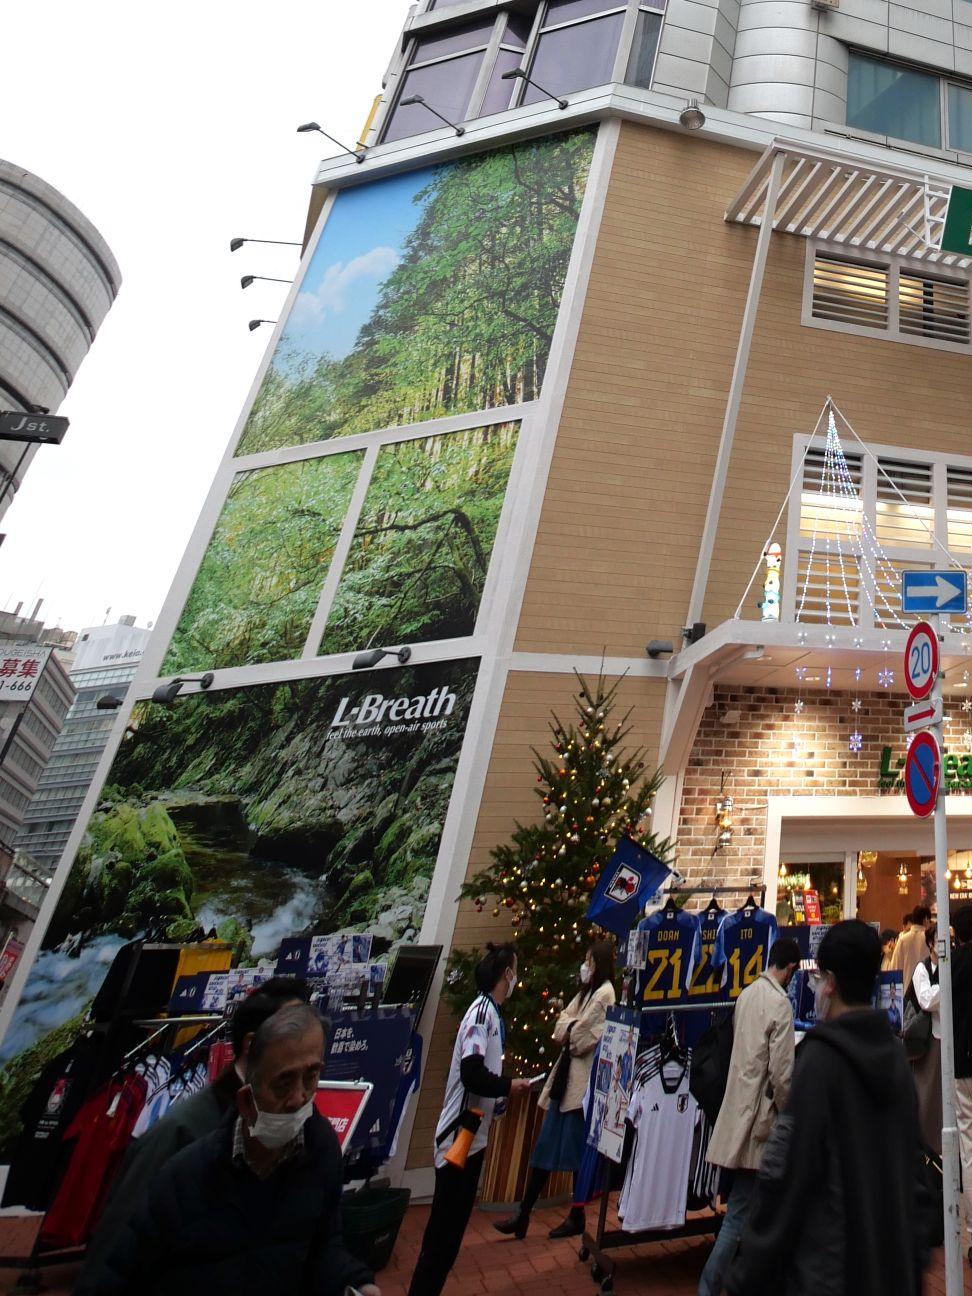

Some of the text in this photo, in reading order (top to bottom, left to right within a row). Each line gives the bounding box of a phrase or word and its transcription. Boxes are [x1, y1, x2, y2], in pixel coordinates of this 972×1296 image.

[0, 658, 40, 679] 募集
[911, 641, 931, 680] 20
[331, 685, 457, 727] L-Breath
[326, 718, 448, 740] feel the earth, open-air sports
[657, 929, 680, 942] DOAN
[740, 927, 753, 940] ITO
[643, 947, 683, 1002] 21
[728, 944, 765, 998] 14
